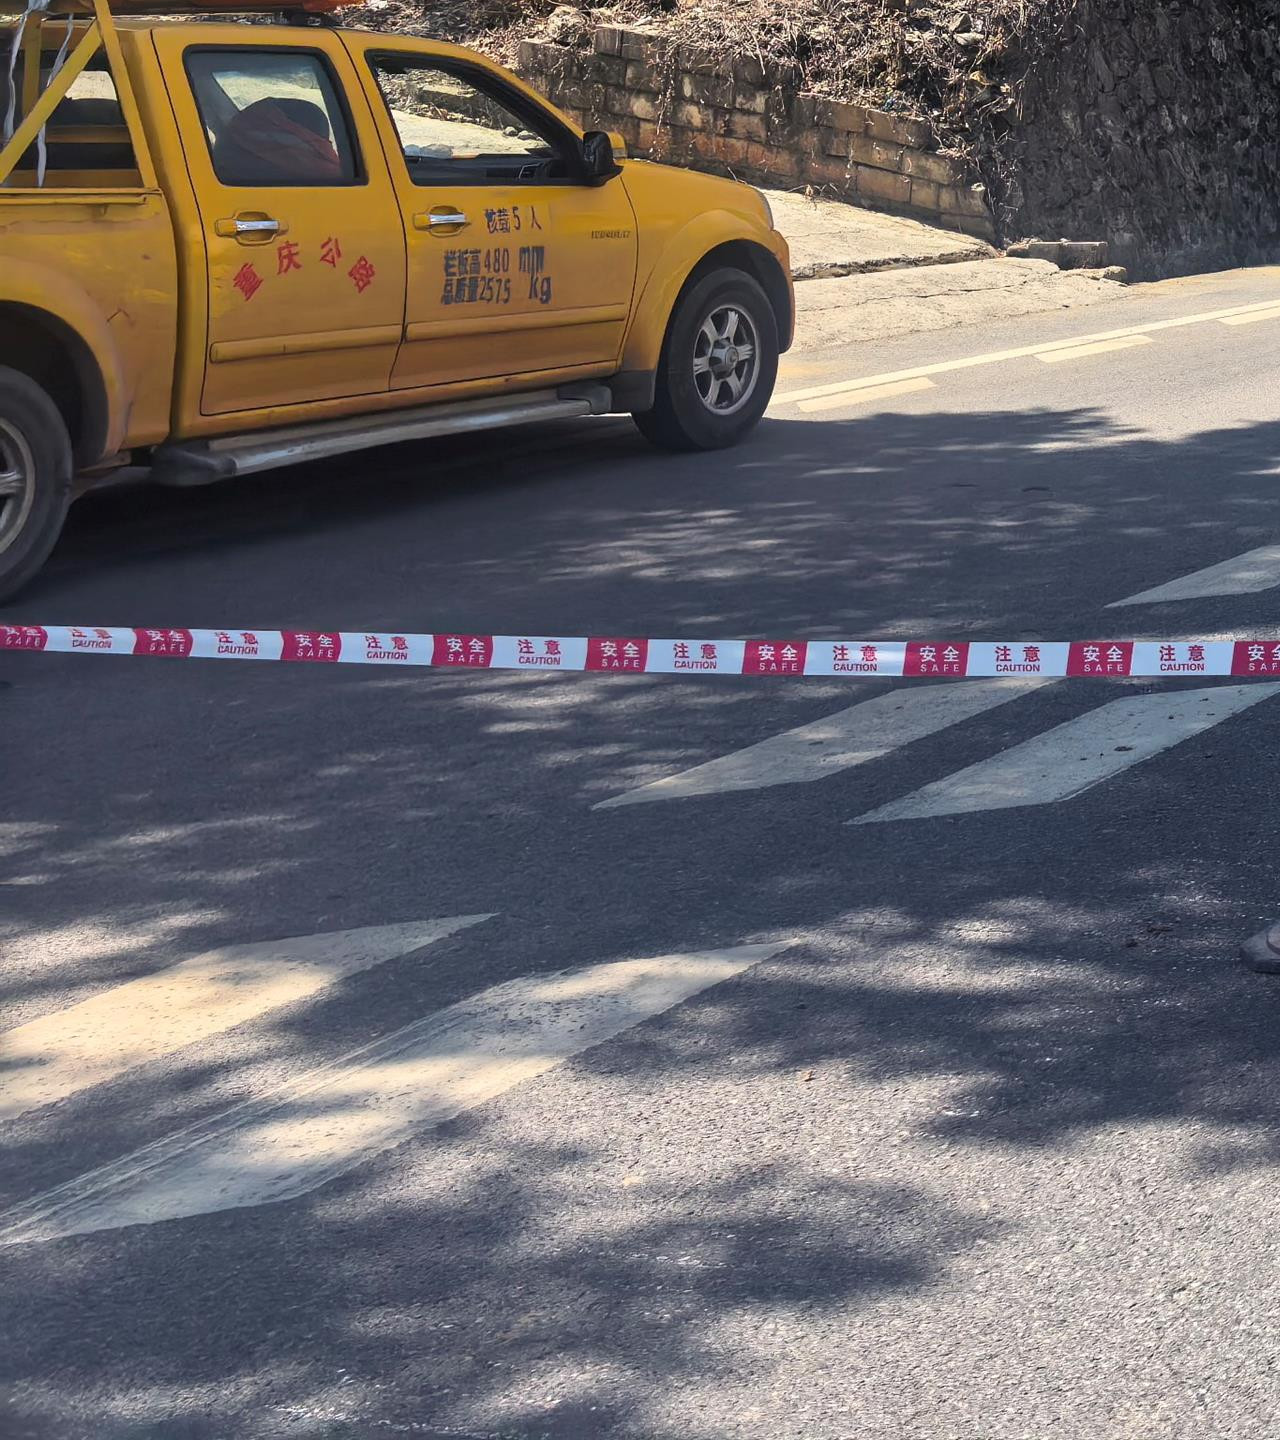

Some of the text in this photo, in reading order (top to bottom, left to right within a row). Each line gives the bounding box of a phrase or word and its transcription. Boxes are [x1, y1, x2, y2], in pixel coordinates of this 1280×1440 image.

[72, 639, 112, 649] CAUTION
[295, 634, 333, 647] 安全
[365, 635, 408, 649] 注意
[447, 638, 485, 653] 安全
[150, 642, 185, 653] SAFE
[217, 644, 258, 655] CAUTION
[518, 639, 561, 654] 注意
[601, 641, 639, 657] 安全
[674, 643, 717, 659] 注意
[297, 648, 333, 658] SAFE
[366, 650, 408, 660] CAUTION
[448, 653, 485, 663] SAFE
[758, 644, 798, 661] 安全
[833, 645, 877, 661] 注意
[920, 646, 960, 662] 安全
[995, 645, 1040, 662] 注意
[1083, 645, 1123, 662] 安全
[1160, 645, 1205, 661] 注意
[518, 655, 561, 665] CAUTION
[602, 658, 639, 668] SAFE
[674, 660, 717, 669] CAUTION
[760, 662, 798, 672] SAFE
[833, 662, 877, 672] CAUTION
[921, 663, 960, 672] SAFE
[996, 663, 1040, 672] CAUTION
[1084, 664, 1123, 672] SAFE
[1160, 663, 1205, 671] CAUTION
